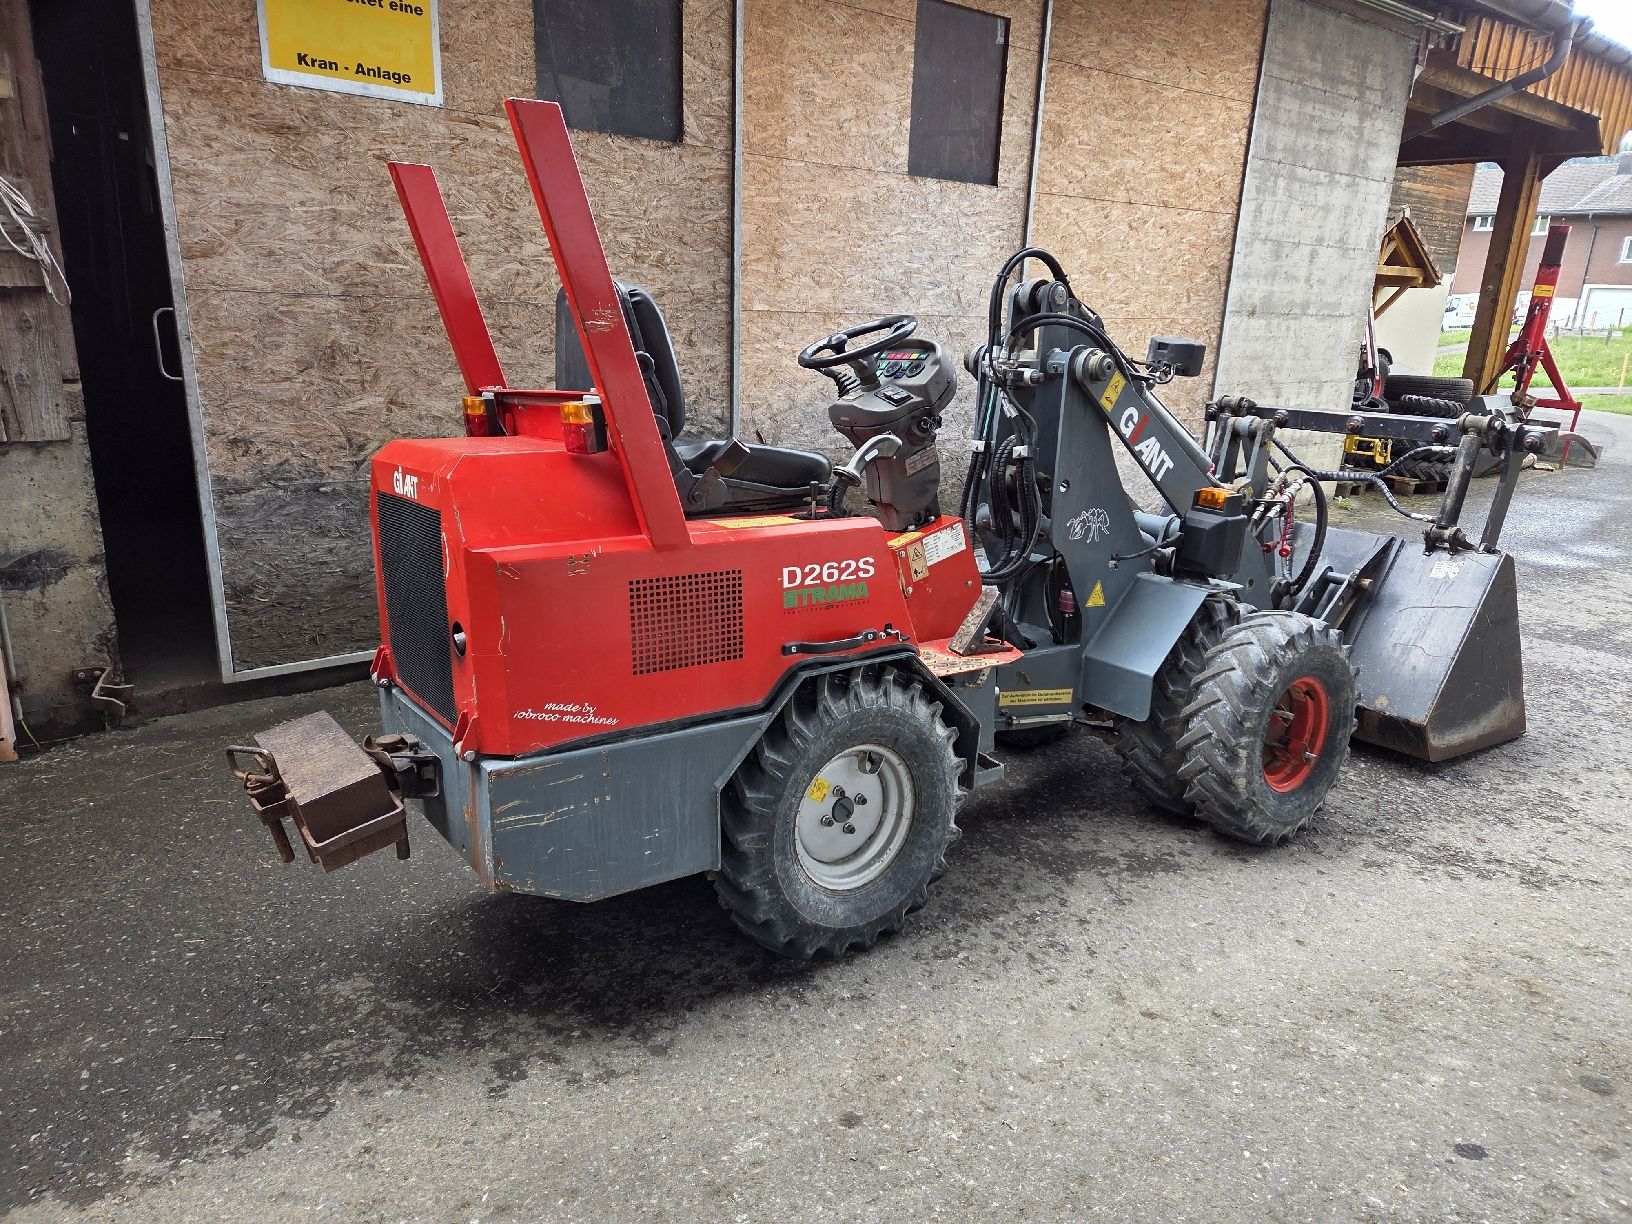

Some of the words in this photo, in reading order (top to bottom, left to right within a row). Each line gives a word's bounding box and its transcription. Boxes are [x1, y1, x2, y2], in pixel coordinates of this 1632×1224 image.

[389, 0, 424, 16] eine
[297, 53, 339, 71] Kran
[354, 63, 411, 84] Anlage
[1119, 406, 1174, 482] GIANT
[393, 465, 418, 500] GIANT
[783, 556, 875, 588] D262S
[544, 702, 581, 712] made
[582, 702, 597, 713] by
[562, 712, 620, 726] machines
